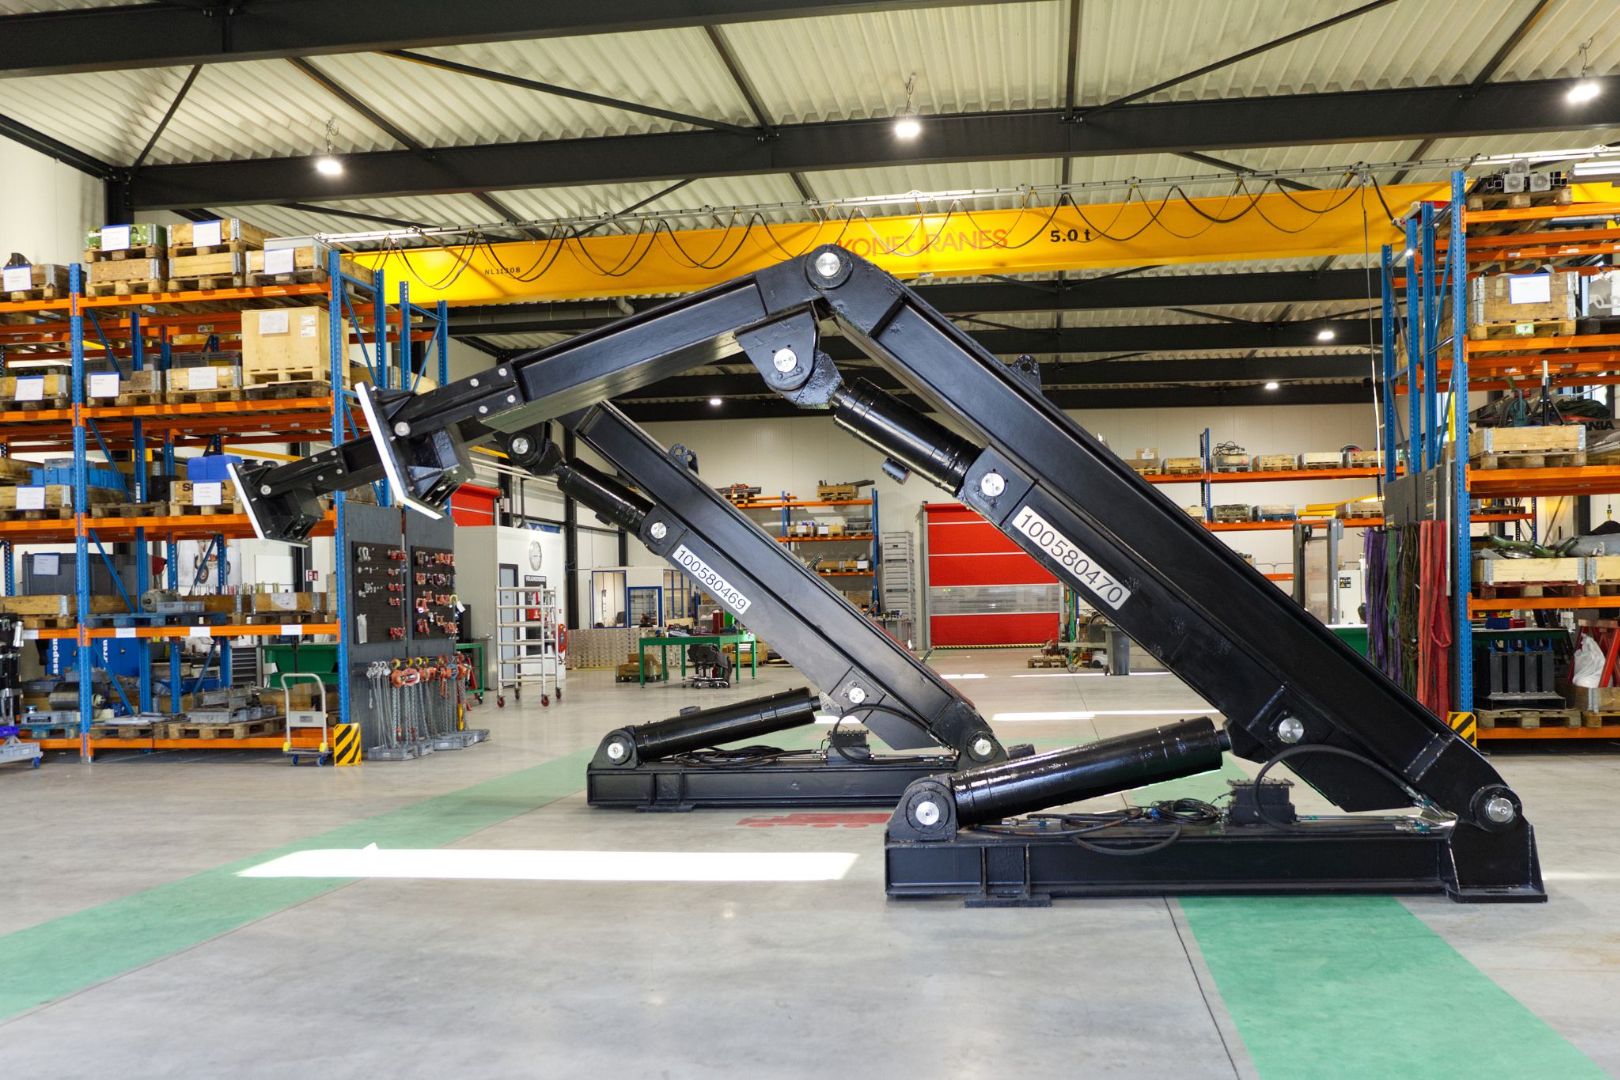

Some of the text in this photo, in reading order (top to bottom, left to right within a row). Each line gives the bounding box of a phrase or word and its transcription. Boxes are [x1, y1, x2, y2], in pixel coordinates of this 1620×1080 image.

[1050, 229, 1090, 242] 5.0 t
[678, 549, 747, 610] 100580469
[1020, 513, 1123, 604] 100580470
